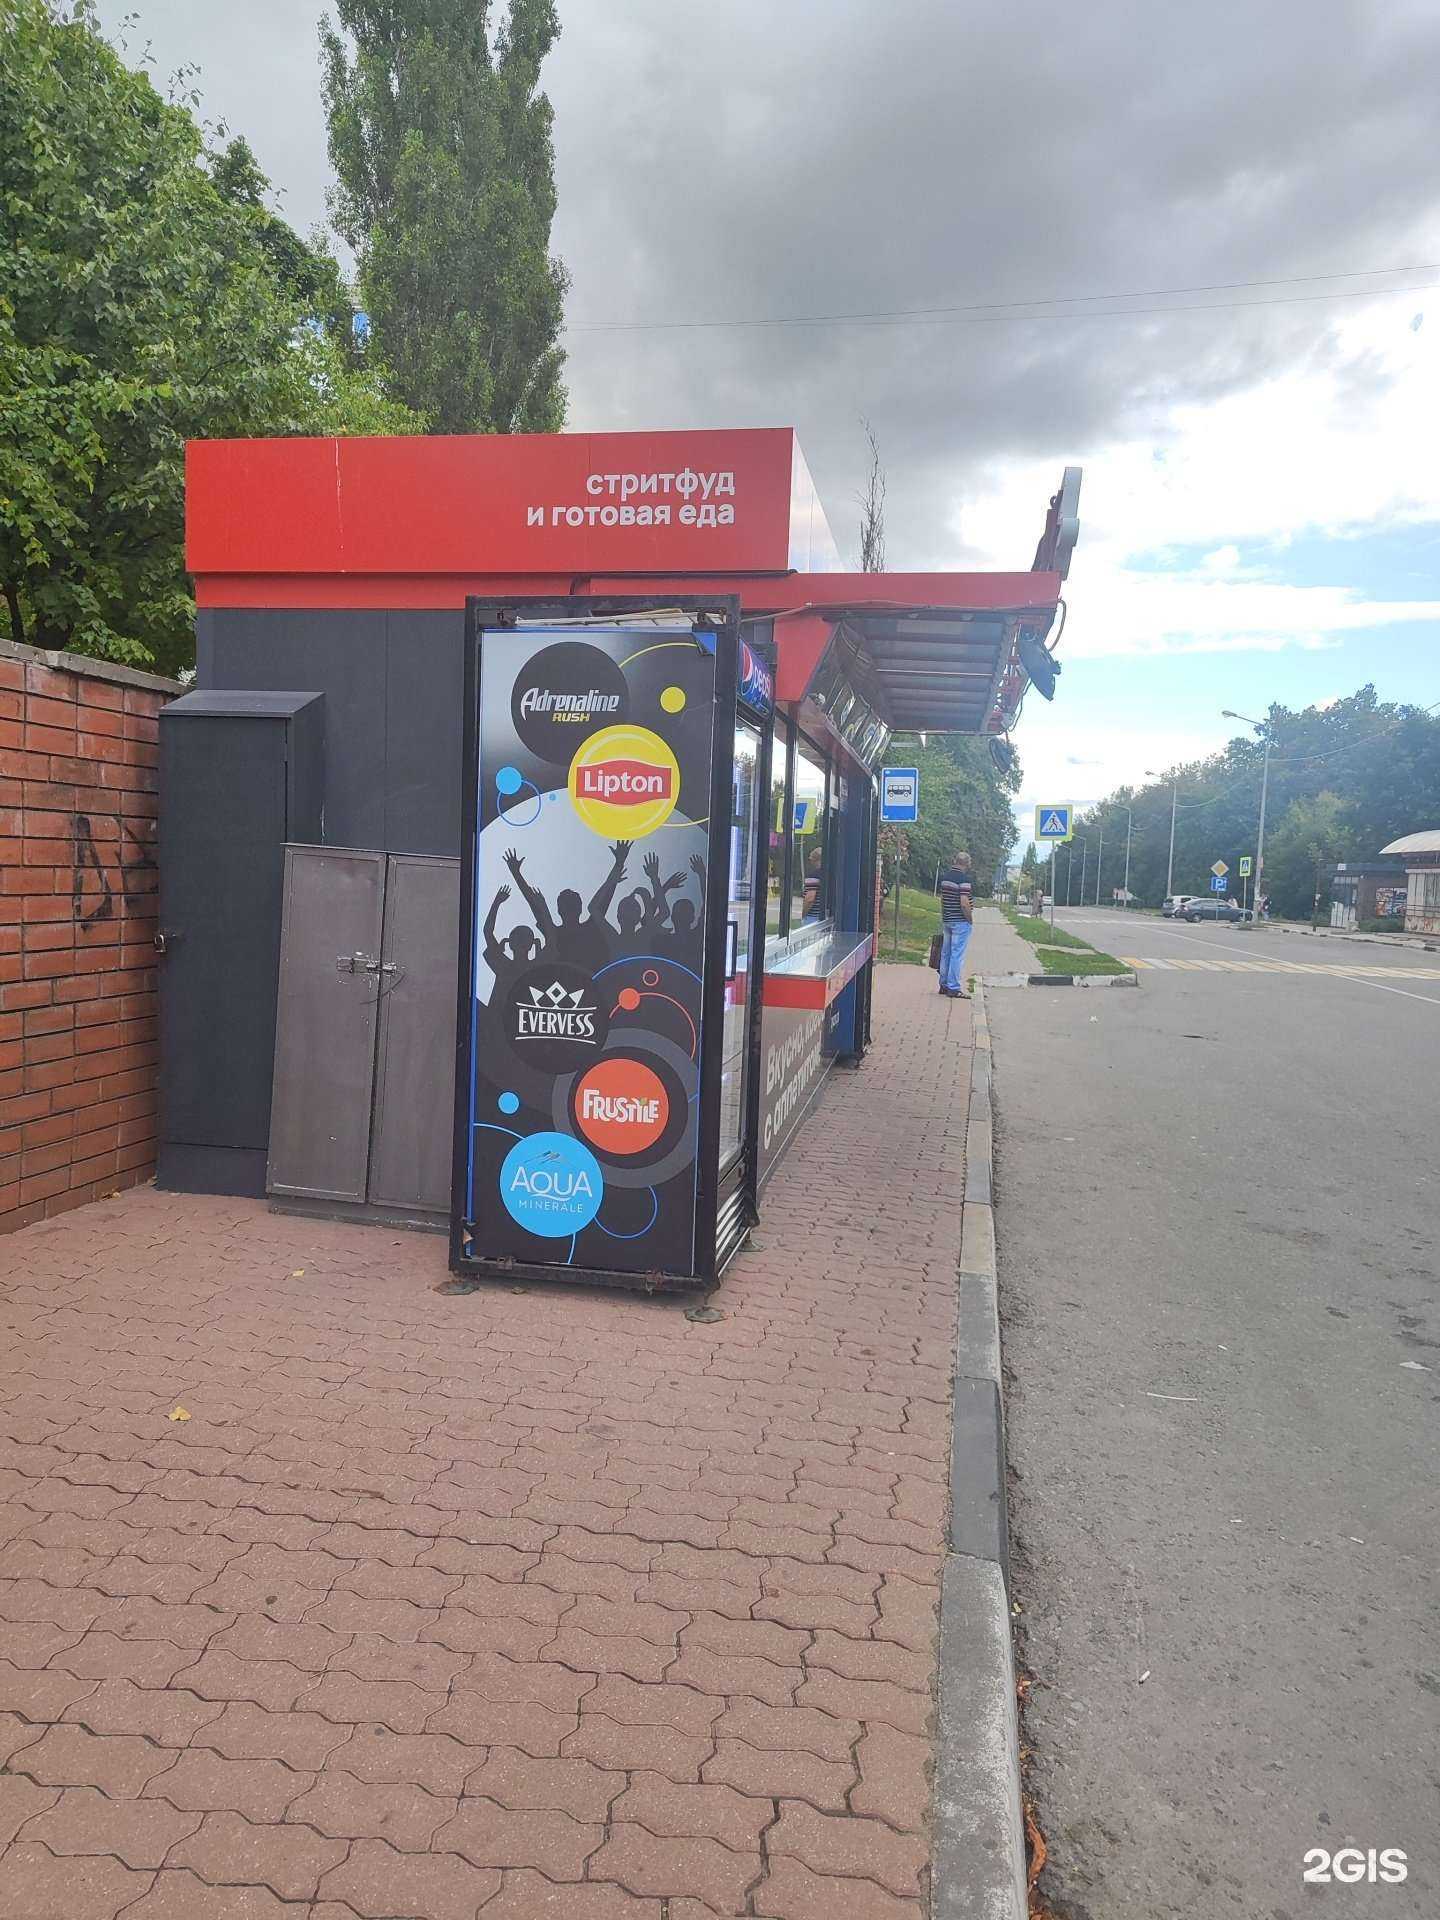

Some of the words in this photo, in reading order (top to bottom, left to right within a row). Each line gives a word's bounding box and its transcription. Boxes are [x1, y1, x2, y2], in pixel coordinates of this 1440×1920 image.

[586, 467, 736, 502] стритфуд
[527, 506, 544, 527] и
[552, 504, 671, 527] готовая
[678, 503, 735, 528] еда
[520, 687, 619, 720] Adrenaline
[552, 712, 590, 722] RUSH
[584, 770, 663, 797] Lipton
[518, 1008, 595, 1037] EVERVESS
[510, 1166, 593, 1201] AQUA
[518, 1200, 584, 1213] MINERALE
